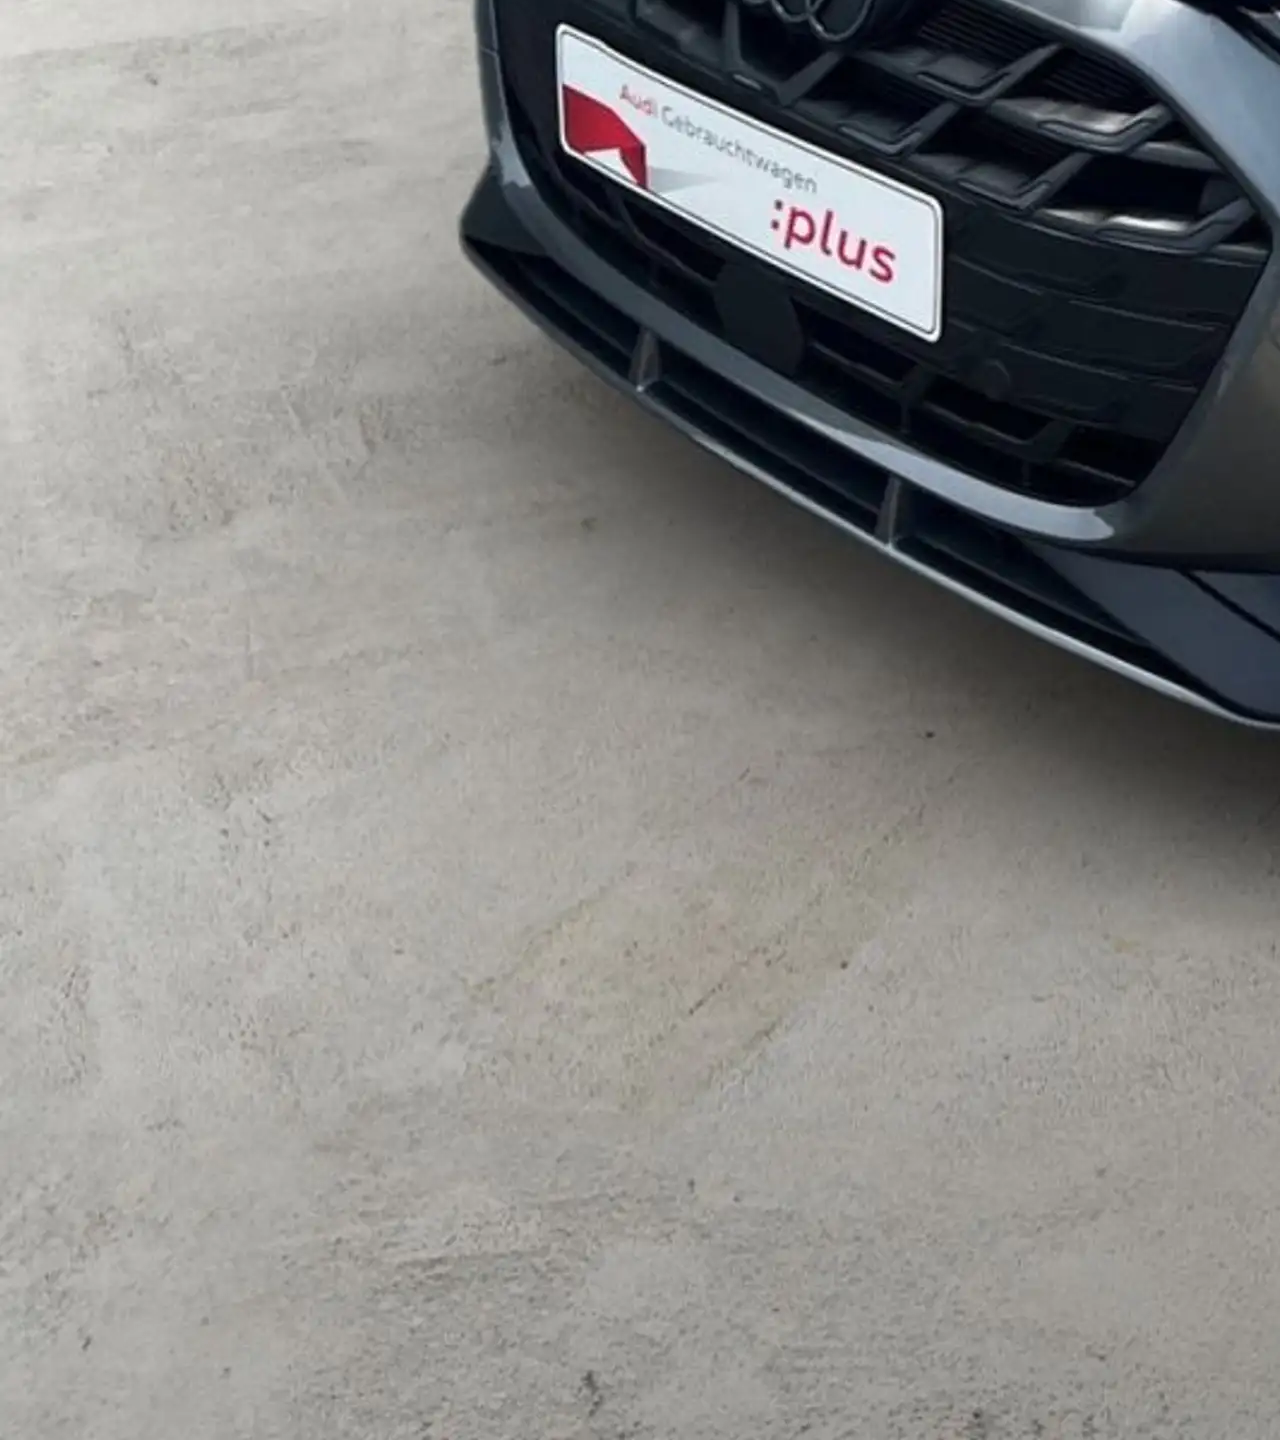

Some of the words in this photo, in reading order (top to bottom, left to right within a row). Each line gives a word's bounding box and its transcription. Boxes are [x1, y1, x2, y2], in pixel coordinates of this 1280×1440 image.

[619, 84, 658, 119] Audi
[661, 105, 818, 195] Gebrauchtwagen
[770, 199, 896, 284] :plus
